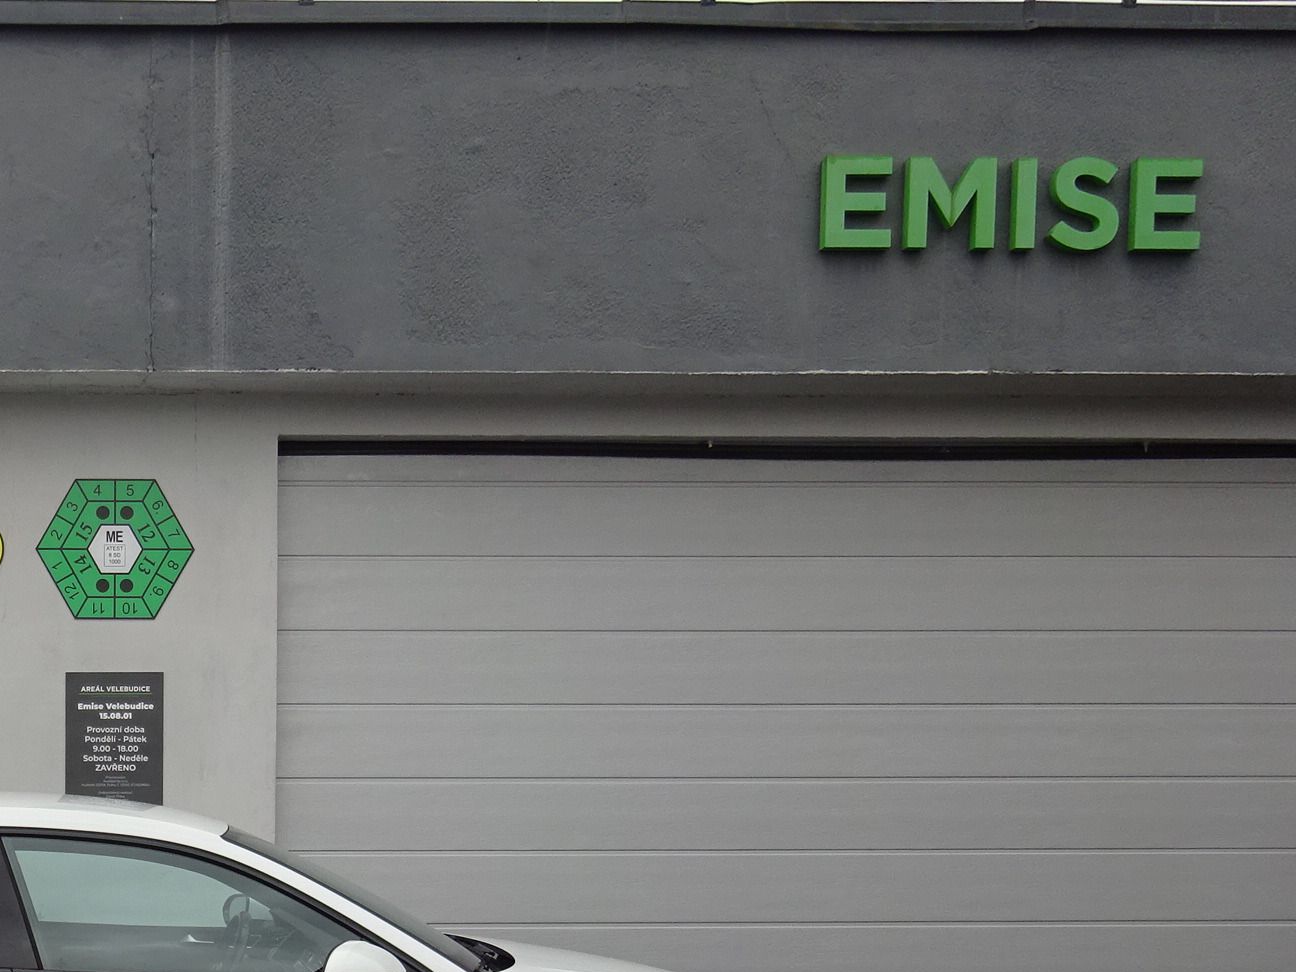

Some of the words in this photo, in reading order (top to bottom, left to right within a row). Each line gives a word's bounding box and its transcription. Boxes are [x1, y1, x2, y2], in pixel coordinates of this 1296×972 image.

[819, 154, 1203, 252] EMISE
[93, 484, 102, 496] 4
[126, 484, 135, 497] 5
[66, 501, 79, 512] 3
[50, 529, 63, 541] 2
[75, 522, 93, 542] 15
[106, 530, 123, 543] ME
[137, 523, 156, 543] 12
[168, 528, 180, 537] 7
[74, 554, 92, 574] 14
[138, 557, 156, 575] 13
[167, 560, 179, 570] 8
[64, 582, 80, 600] 12
[92, 602, 105, 614] 11
[122, 602, 137, 615] 10
[106, 685, 151, 693] VELEBUDICE
[77, 702, 104, 710] Emise
[105, 702, 154, 710] Velebudice
[99, 712, 132, 720] 15.08.01
[86, 726, 122, 734] Provozní
[124, 726, 145, 734] doba
[84, 735, 116, 743] Pondělí
[123, 735, 147, 743] Pátek
[119, 754, 149, 762] Neděle
[95, 763, 136, 772] ZAVŘENO
